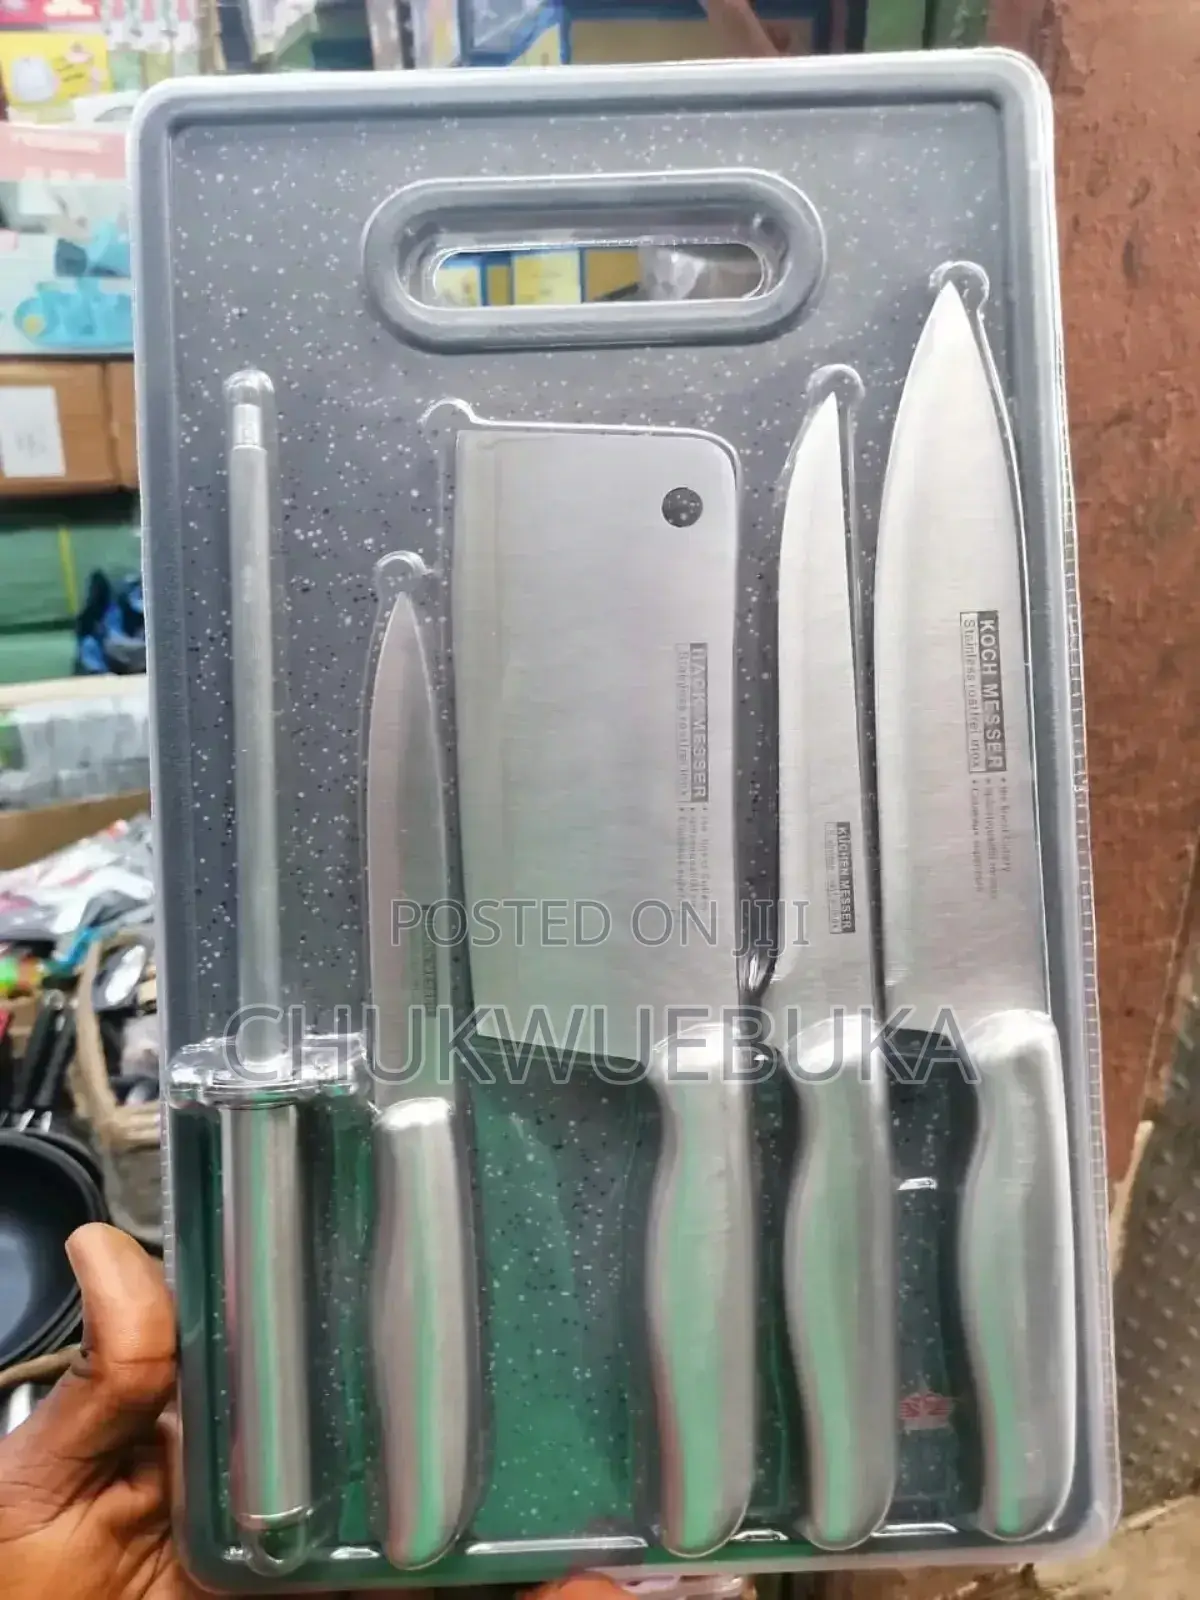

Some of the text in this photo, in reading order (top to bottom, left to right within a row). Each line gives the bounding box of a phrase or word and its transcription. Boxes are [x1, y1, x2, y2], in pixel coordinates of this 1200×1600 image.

[979, 618, 998, 675] KOCH
[692, 717, 707, 799] MESSER
[982, 683, 1003, 769] MESSER
[840, 880, 853, 929] MESSER
